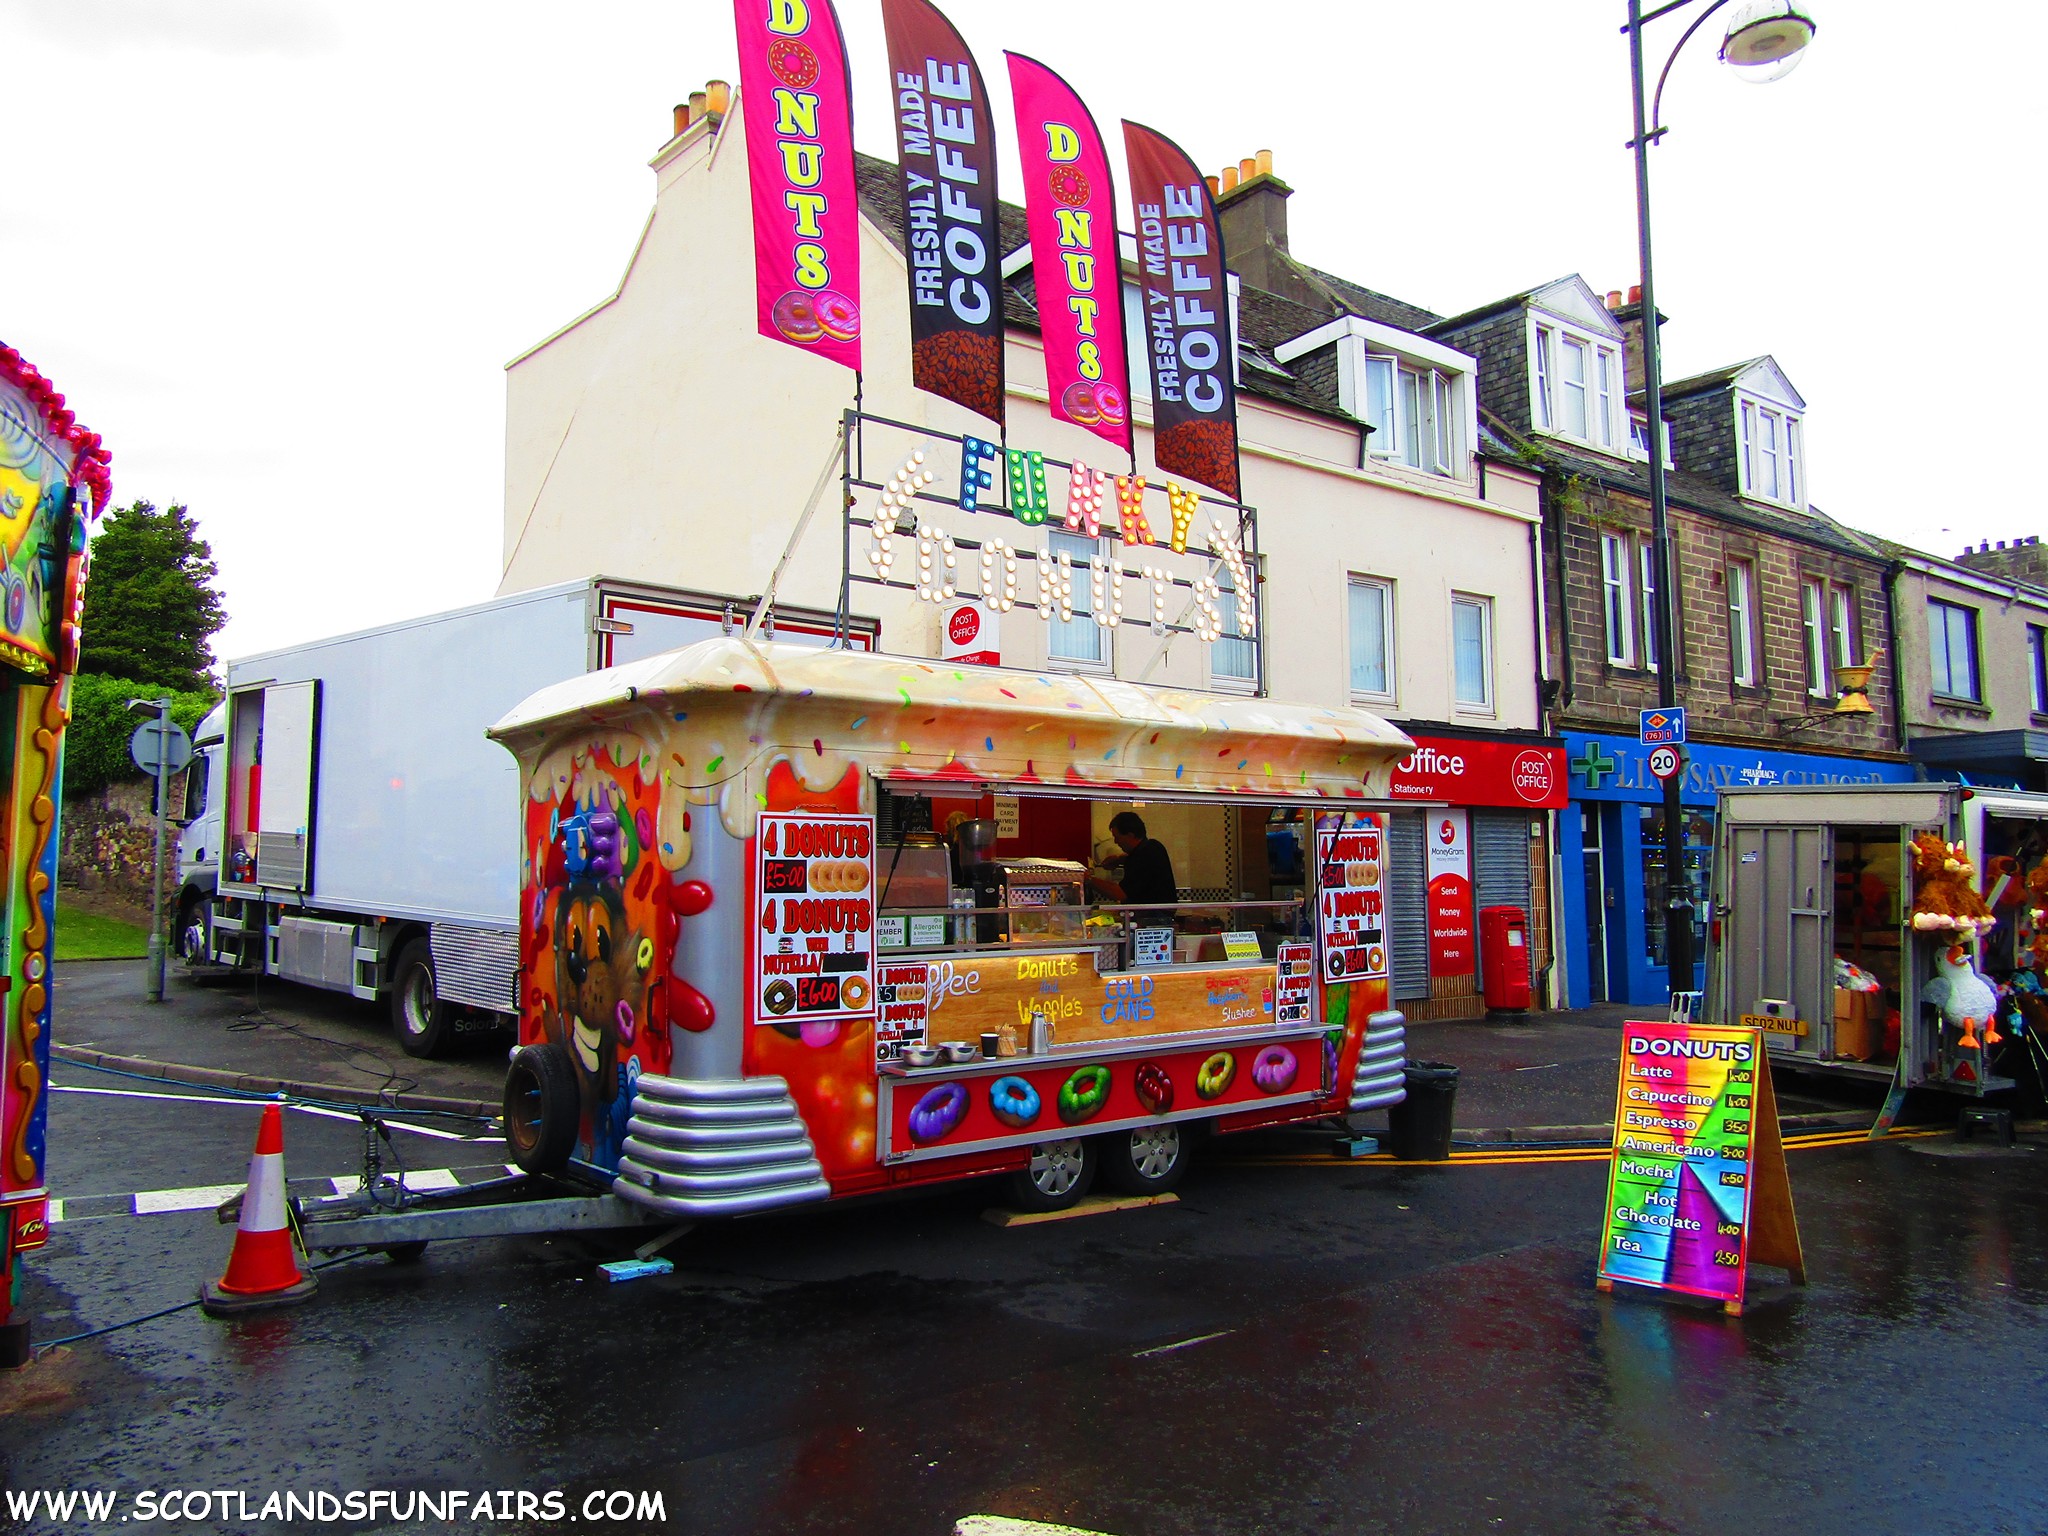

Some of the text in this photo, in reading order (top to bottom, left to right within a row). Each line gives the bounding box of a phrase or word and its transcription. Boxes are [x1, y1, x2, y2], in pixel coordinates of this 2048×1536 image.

[896, 70, 945, 307] FRESHLY MADE
[925, 57, 991, 326] COFFEE
[1043, 121, 1102, 382] DONUTS
[1138, 202, 1183, 402] FRESHLY MADE
[1163, 182, 1224, 414] COFFEE
[959, 433, 1200, 556] FUNKY
[915, 523, 1222, 644] DONUTS
[955, 613, 973, 626] POST
[952, 625, 977, 639] OFFICE
[1645, 731, 1662, 740] (76)
[1397, 747, 1465, 776] Office
[1521, 761, 1545, 774] POST
[1652, 755, 1674, 770] 20
[1614, 749, 1735, 794] LISAY
[1742, 768, 1776, 780] PHARMACY
[1394, 783, 1434, 795] Stationery
[1516, 774, 1548, 789] OFFICE
[764, 822, 870, 858] 4 DONUTS
[1331, 836, 1379, 862] DONUTS
[1441, 886, 1458, 896] Send
[1323, 890, 1382, 918] 4 DONUTS
[1439, 908, 1460, 917] Money
[762, 898, 870, 934] 4 DONUTS
[914, 923, 942, 932] Allergens
[1433, 927, 1468, 937] Worldwide
[1443, 949, 1459, 958] Here
[886, 967, 926, 985] DONUTS
[1017, 957, 1079, 980] Donut's
[1105, 975, 1154, 1000] COLD
[885, 1003, 927, 1021] DONUTS
[1101, 997, 1155, 1025] CANS
[1777, 1019, 1800, 1032] NUT
[1629, 1037, 1752, 1062] DONUTS
[1629, 1062, 1673, 1079] Latte
[1627, 1086, 1714, 1107] Capuccino
[1625, 1111, 1697, 1130] Espresso
[1622, 1136, 1716, 1158] Americano
[1620, 1160, 1675, 1179] Mocha
[1644, 1190, 1678, 1208] Hot
[1615, 1207, 1702, 1231] Chocolate
[1612, 1235, 1642, 1253] Tea
